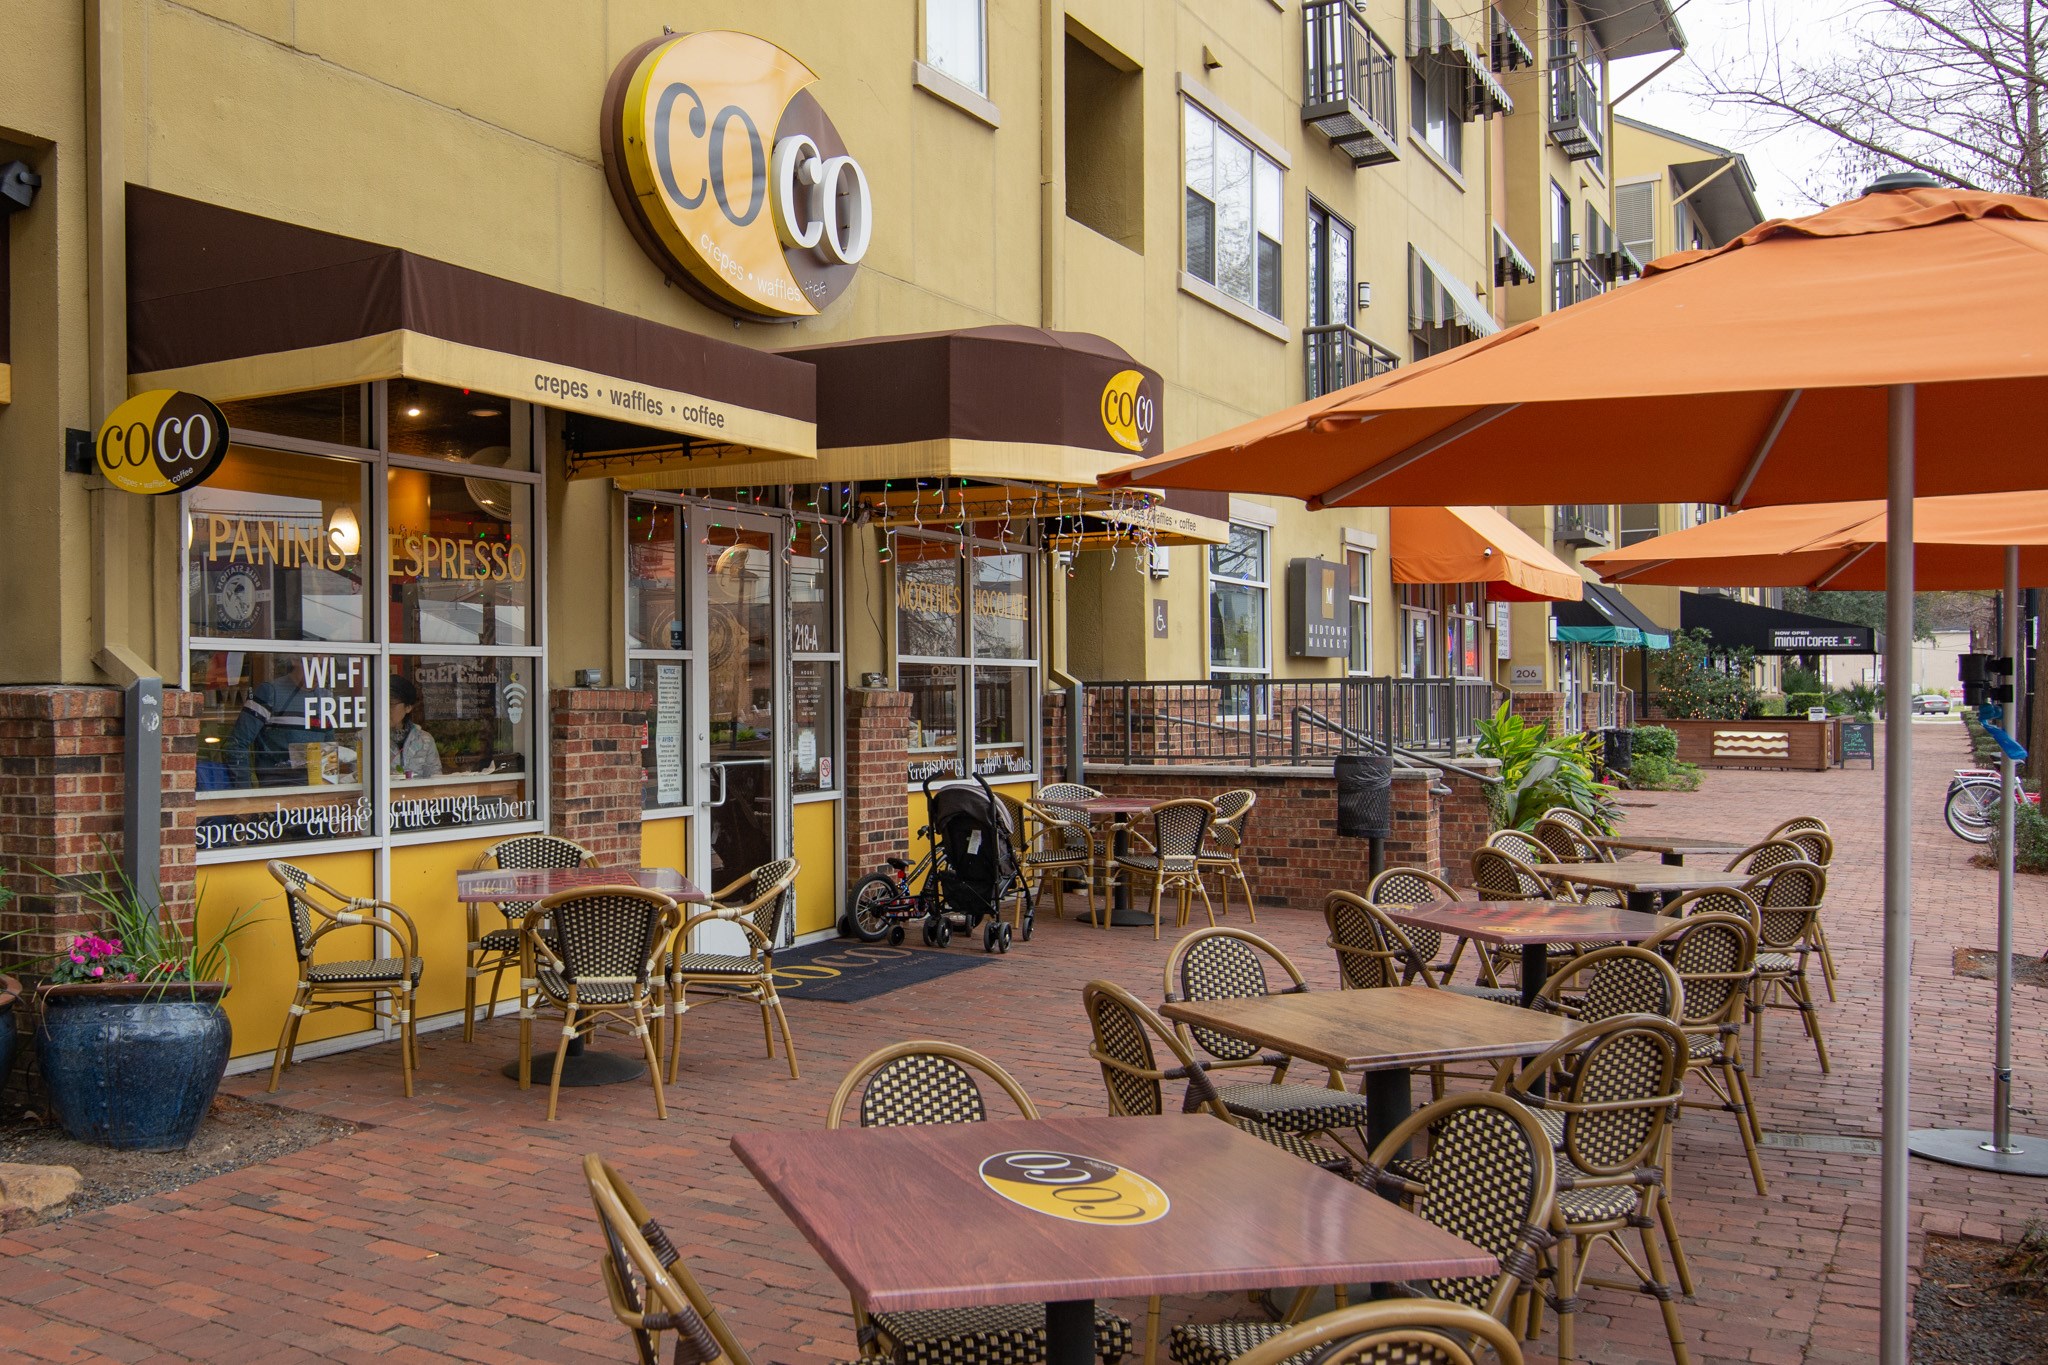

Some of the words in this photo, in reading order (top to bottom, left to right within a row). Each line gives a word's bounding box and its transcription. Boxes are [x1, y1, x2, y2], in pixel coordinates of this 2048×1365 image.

[701, 233, 744, 281] crepes
[757, 277, 800, 302] waffles
[534, 372, 589, 399] crepes
[610, 388, 663, 416] waffles
[683, 405, 725, 429] coffee
[118, 475, 138, 488] crepes
[172, 467, 194, 483] coffee
[1179, 517, 1197, 532] coffee
[208, 514, 347, 572] PANINIS
[389, 534, 527, 583] ESPRESSO
[974, 587, 1028, 621] HOCOLATE
[795, 624, 818, 651] 218-A
[1308, 624, 1347, 637] MIDTOWN
[1774, 636, 1805, 647] MINUTI
[1807, 636, 1838, 647] COFFEE
[1308, 637, 1347, 649] MARKET
[302, 656, 369, 689] WI-FI
[468, 673, 498, 684] Month
[1516, 669, 1537, 679] 206
[304, 696, 368, 730] FREE
[922, 755, 964, 774] raspberry
[276, 803, 351, 826] banana
[356, 796, 372, 820] &
[391, 794, 480, 817] cinnamon
